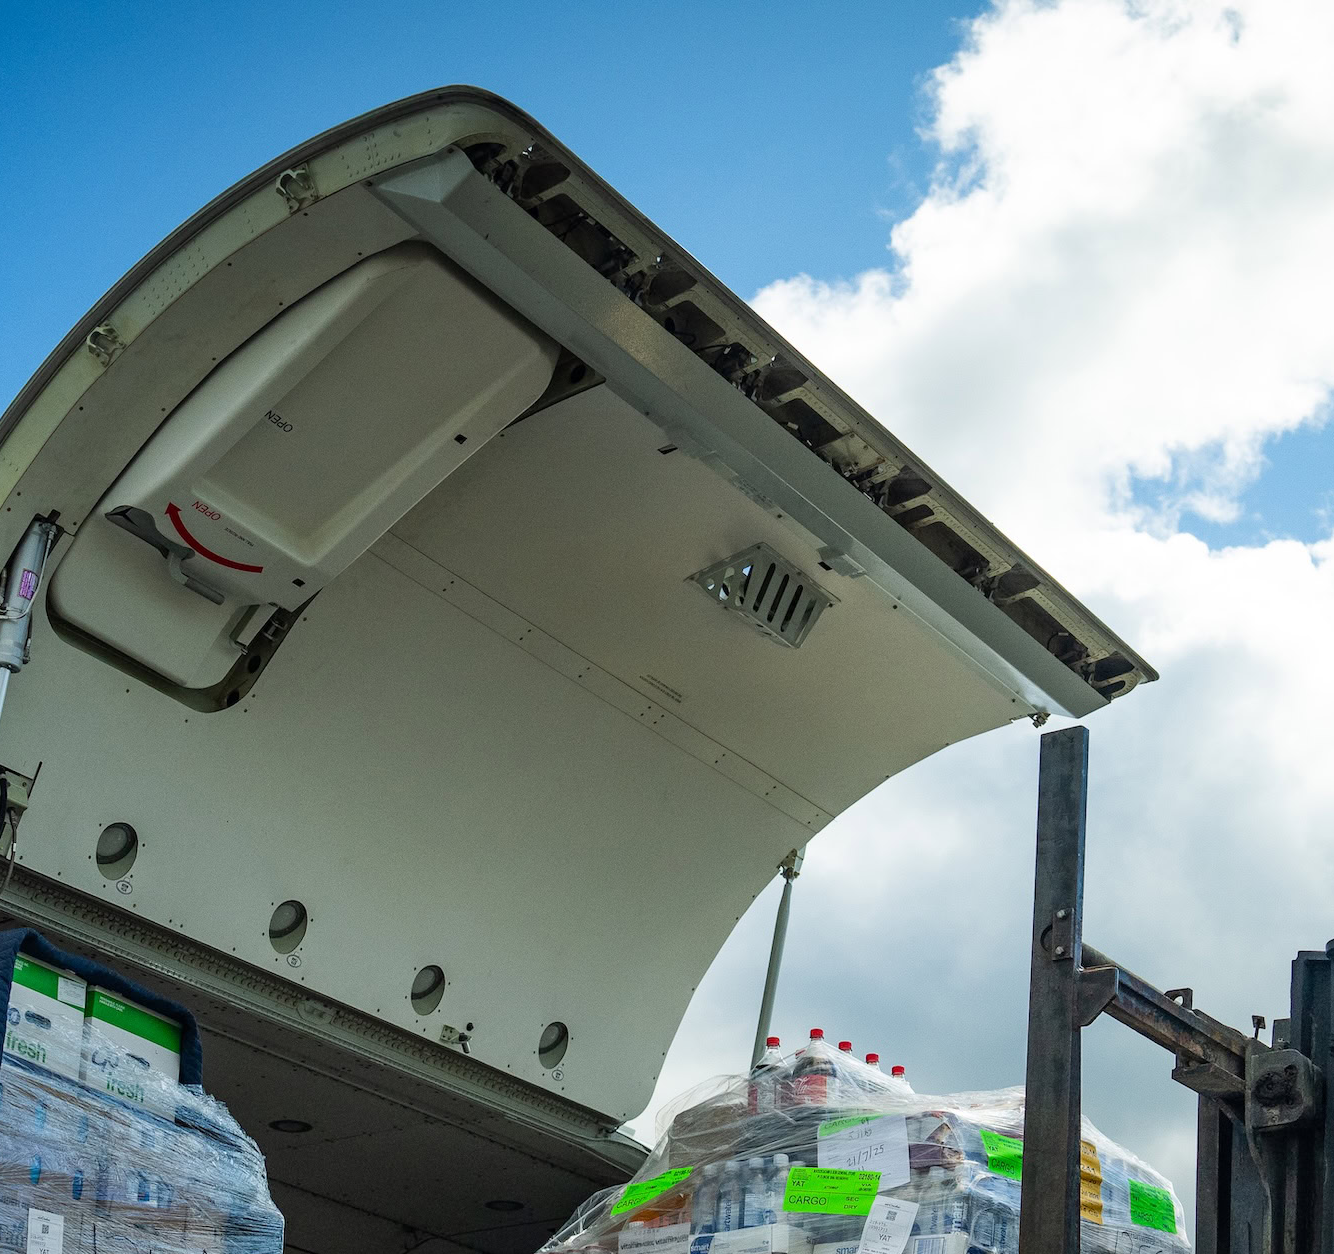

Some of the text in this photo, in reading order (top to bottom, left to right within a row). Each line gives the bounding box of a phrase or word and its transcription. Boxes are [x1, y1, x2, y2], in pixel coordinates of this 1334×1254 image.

[264, 409, 293, 433] OPEN
[191, 501, 221, 521] OPEN
[991, 1158, 1015, 1175] CARGO
[788, 1194, 827, 1206] CARGO
[878, 1233, 892, 1242] YAT
